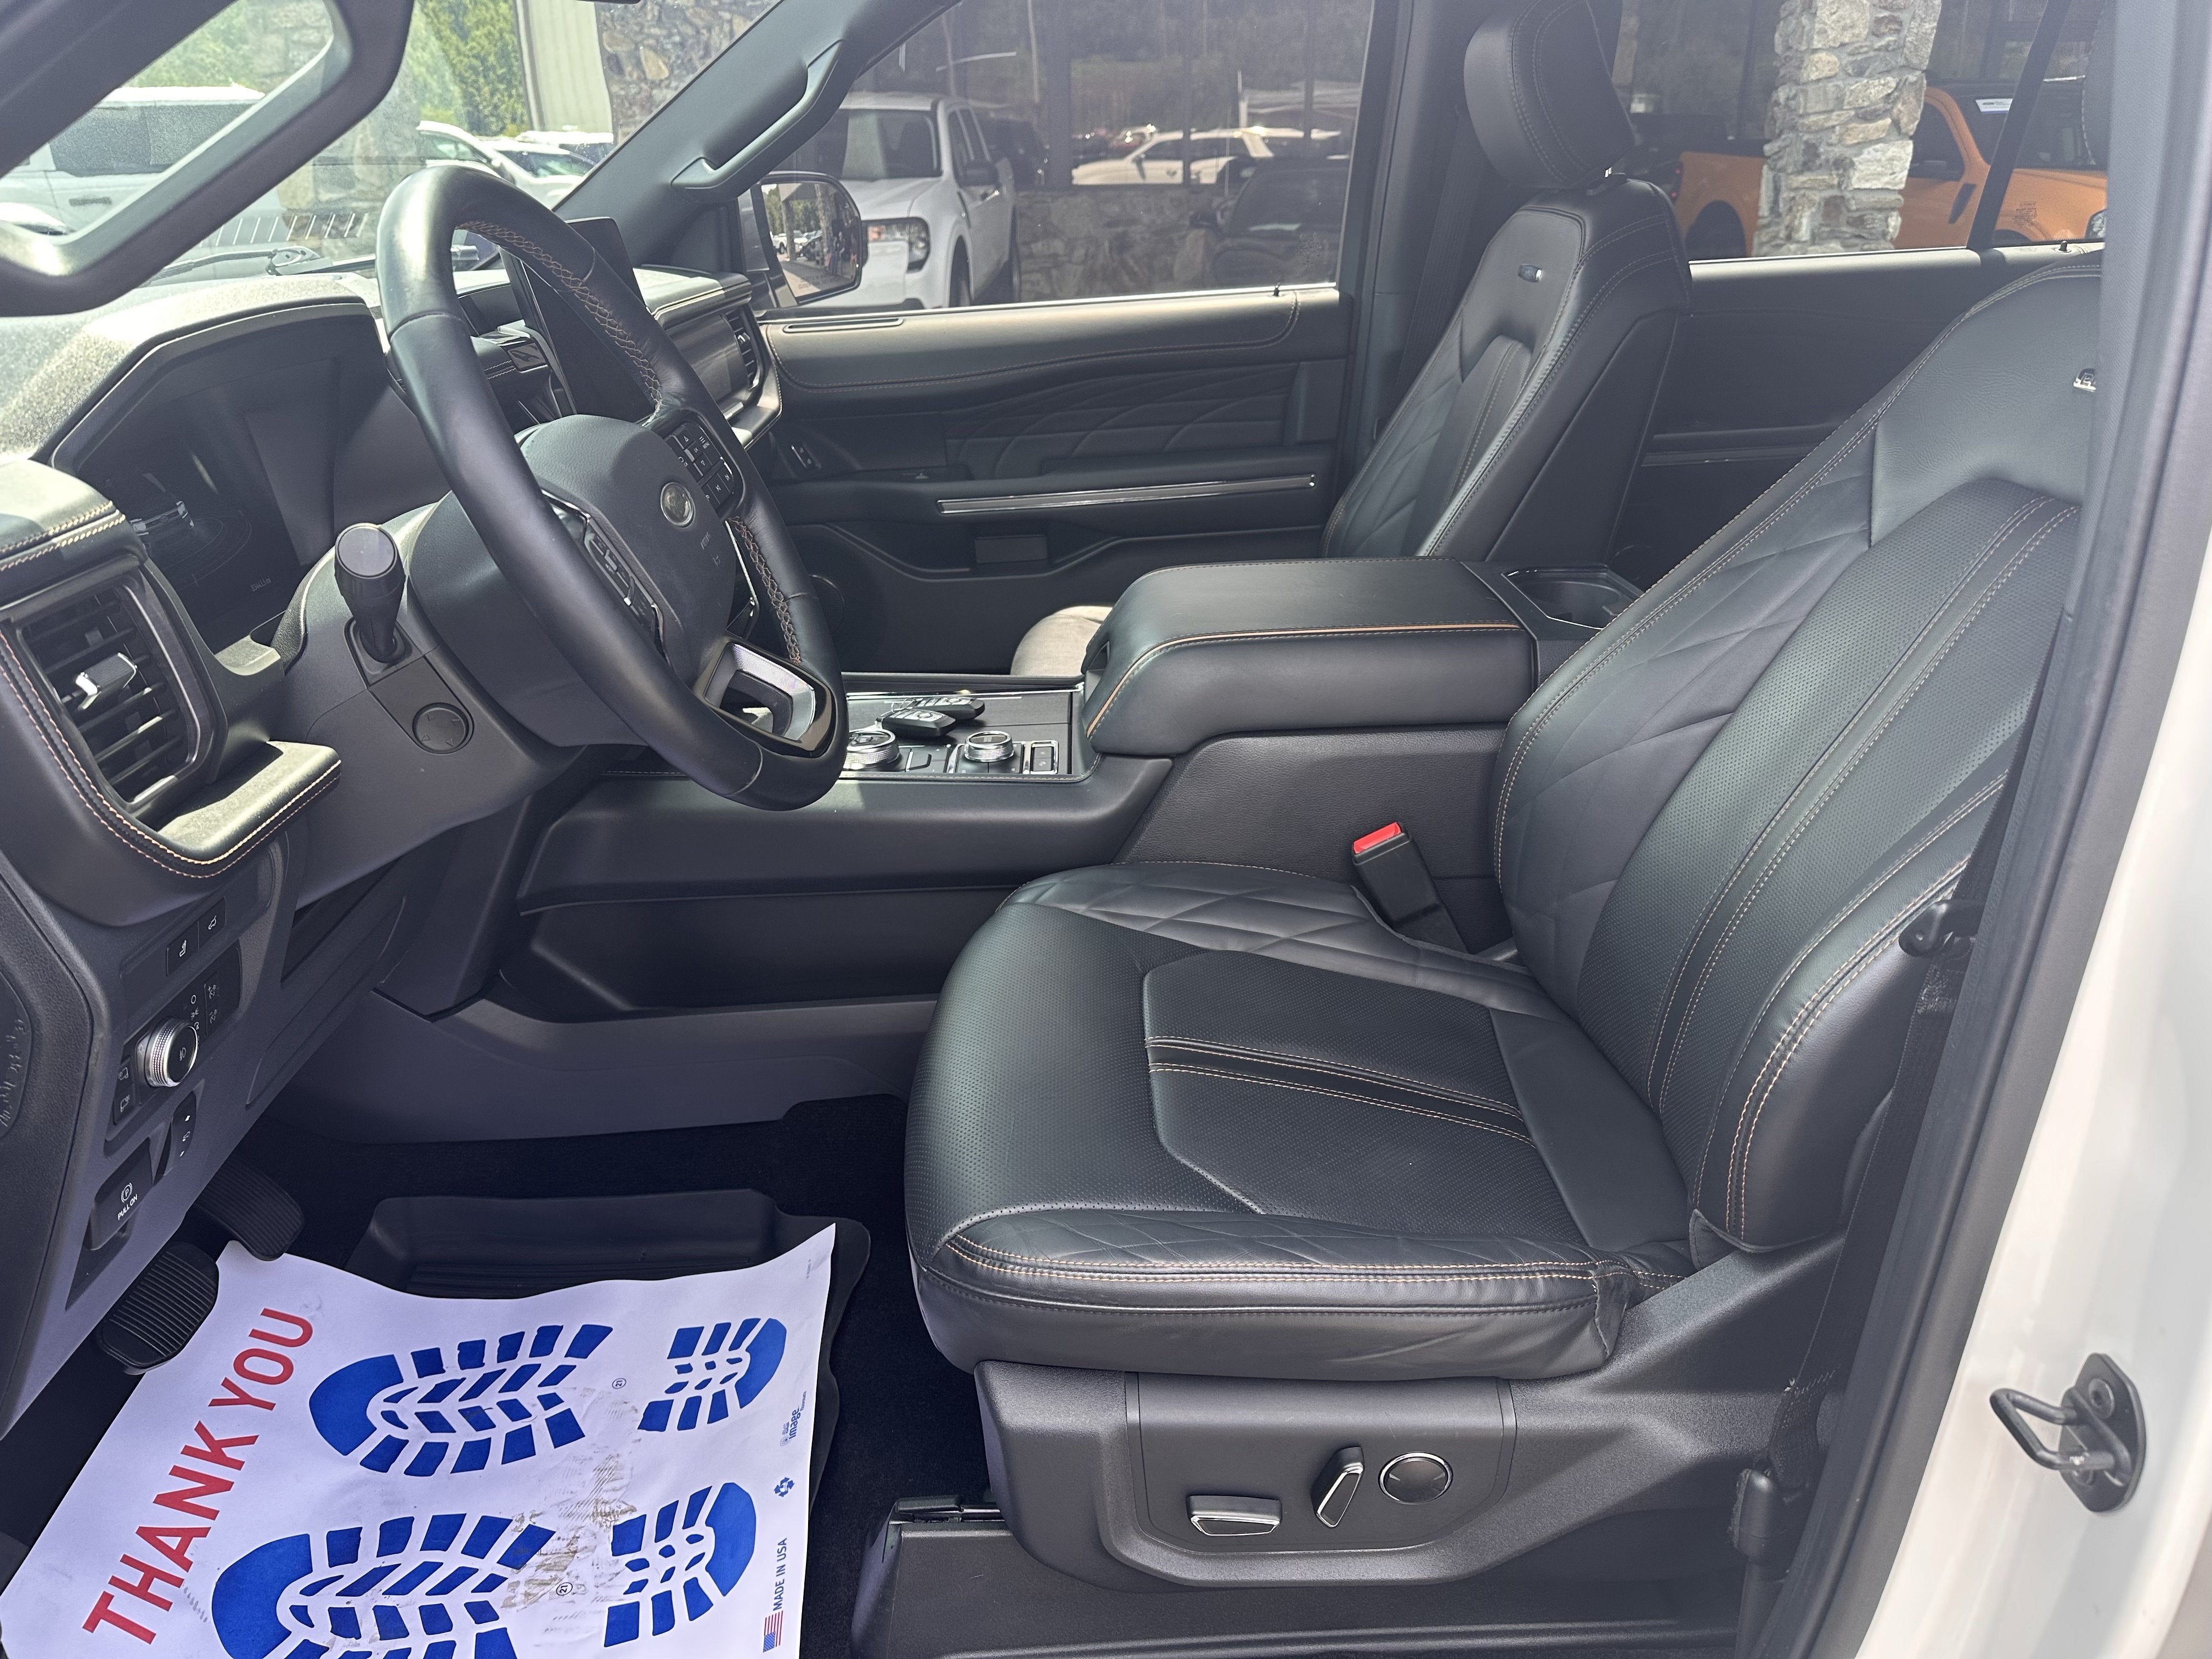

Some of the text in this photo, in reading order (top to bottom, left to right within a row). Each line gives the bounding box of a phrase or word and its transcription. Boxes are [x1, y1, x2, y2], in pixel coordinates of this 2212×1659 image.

[117, 1193, 138, 1221] PULL ON
[82, 1307, 313, 1645] THANK YOU
[772, 1537, 787, 1611] MADE IN USA
